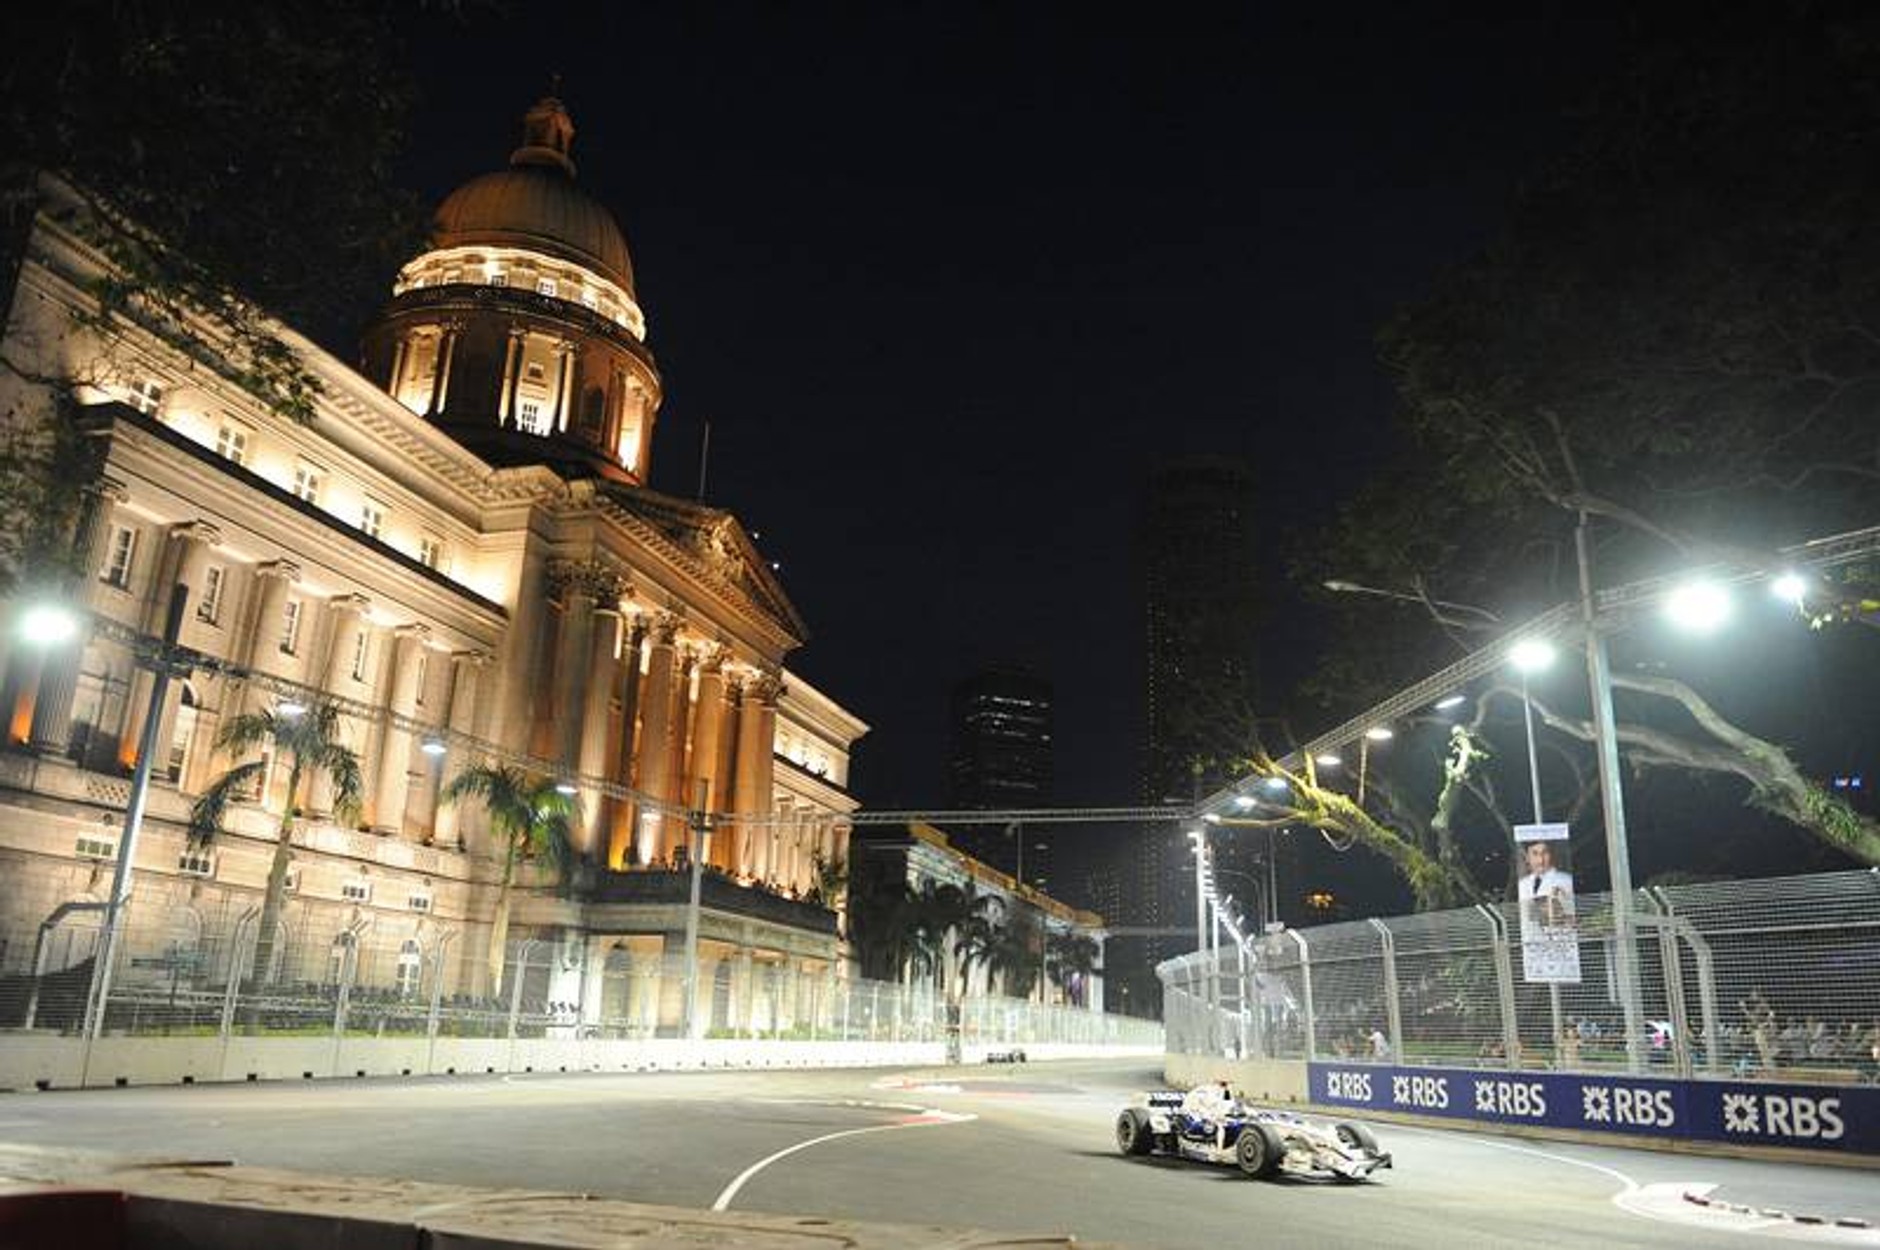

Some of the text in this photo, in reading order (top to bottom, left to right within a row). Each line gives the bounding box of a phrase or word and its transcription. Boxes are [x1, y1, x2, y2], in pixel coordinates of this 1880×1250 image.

[1342, 1073, 1372, 1101] RBS
[1412, 1076, 1449, 1108] RBS
[1498, 1082, 1546, 1117] RBS
[1614, 1088, 1675, 1127] RBS
[1765, 1097, 1844, 1138] RBS
